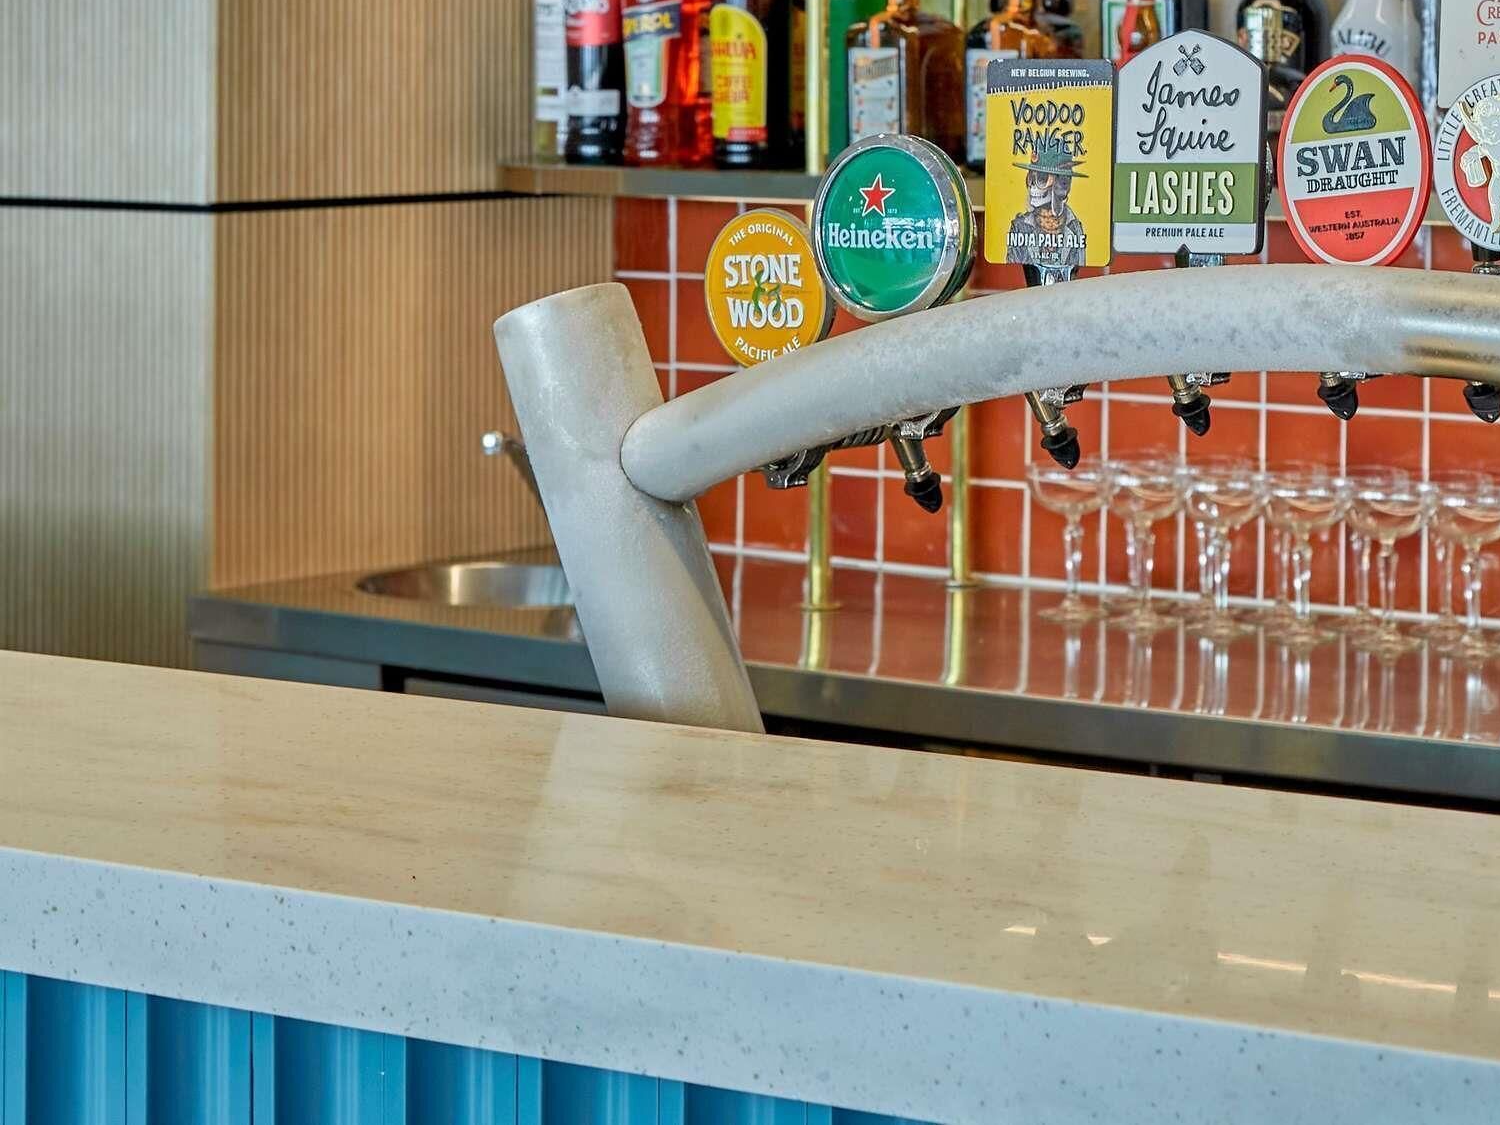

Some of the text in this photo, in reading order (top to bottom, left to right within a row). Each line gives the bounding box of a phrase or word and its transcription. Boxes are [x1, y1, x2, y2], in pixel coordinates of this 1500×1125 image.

[1011, 68, 1027, 78] NEW
[1028, 68, 1056, 78] BELGIUM
[1142, 60, 1240, 114] James
[1010, 98, 1086, 126] VOODOO
[1136, 106, 1236, 160] Squire
[1437, 110, 1463, 162] LITTLE
[1296, 136, 1406, 177] SWAN
[1128, 169, 1236, 216] LASHES
[1307, 169, 1399, 193] DRAUGHT
[1308, 217, 1400, 233] WESTERN AUSTRALIA
[1344, 210, 1362, 219] EST.
[728, 223, 795, 246] THE ORIGINAL
[828, 221, 935, 250] Heineken
[1007, 231, 1087, 248] INDIA PALE ALE
[1145, 227, 1225, 238] PREMIUM PALE ALE
[1345, 232, 1365, 241] 1857
[723, 253, 803, 289] STONE
[726, 295, 805, 329] WOOD
[735, 335, 801, 362] PACIFIC ALE
